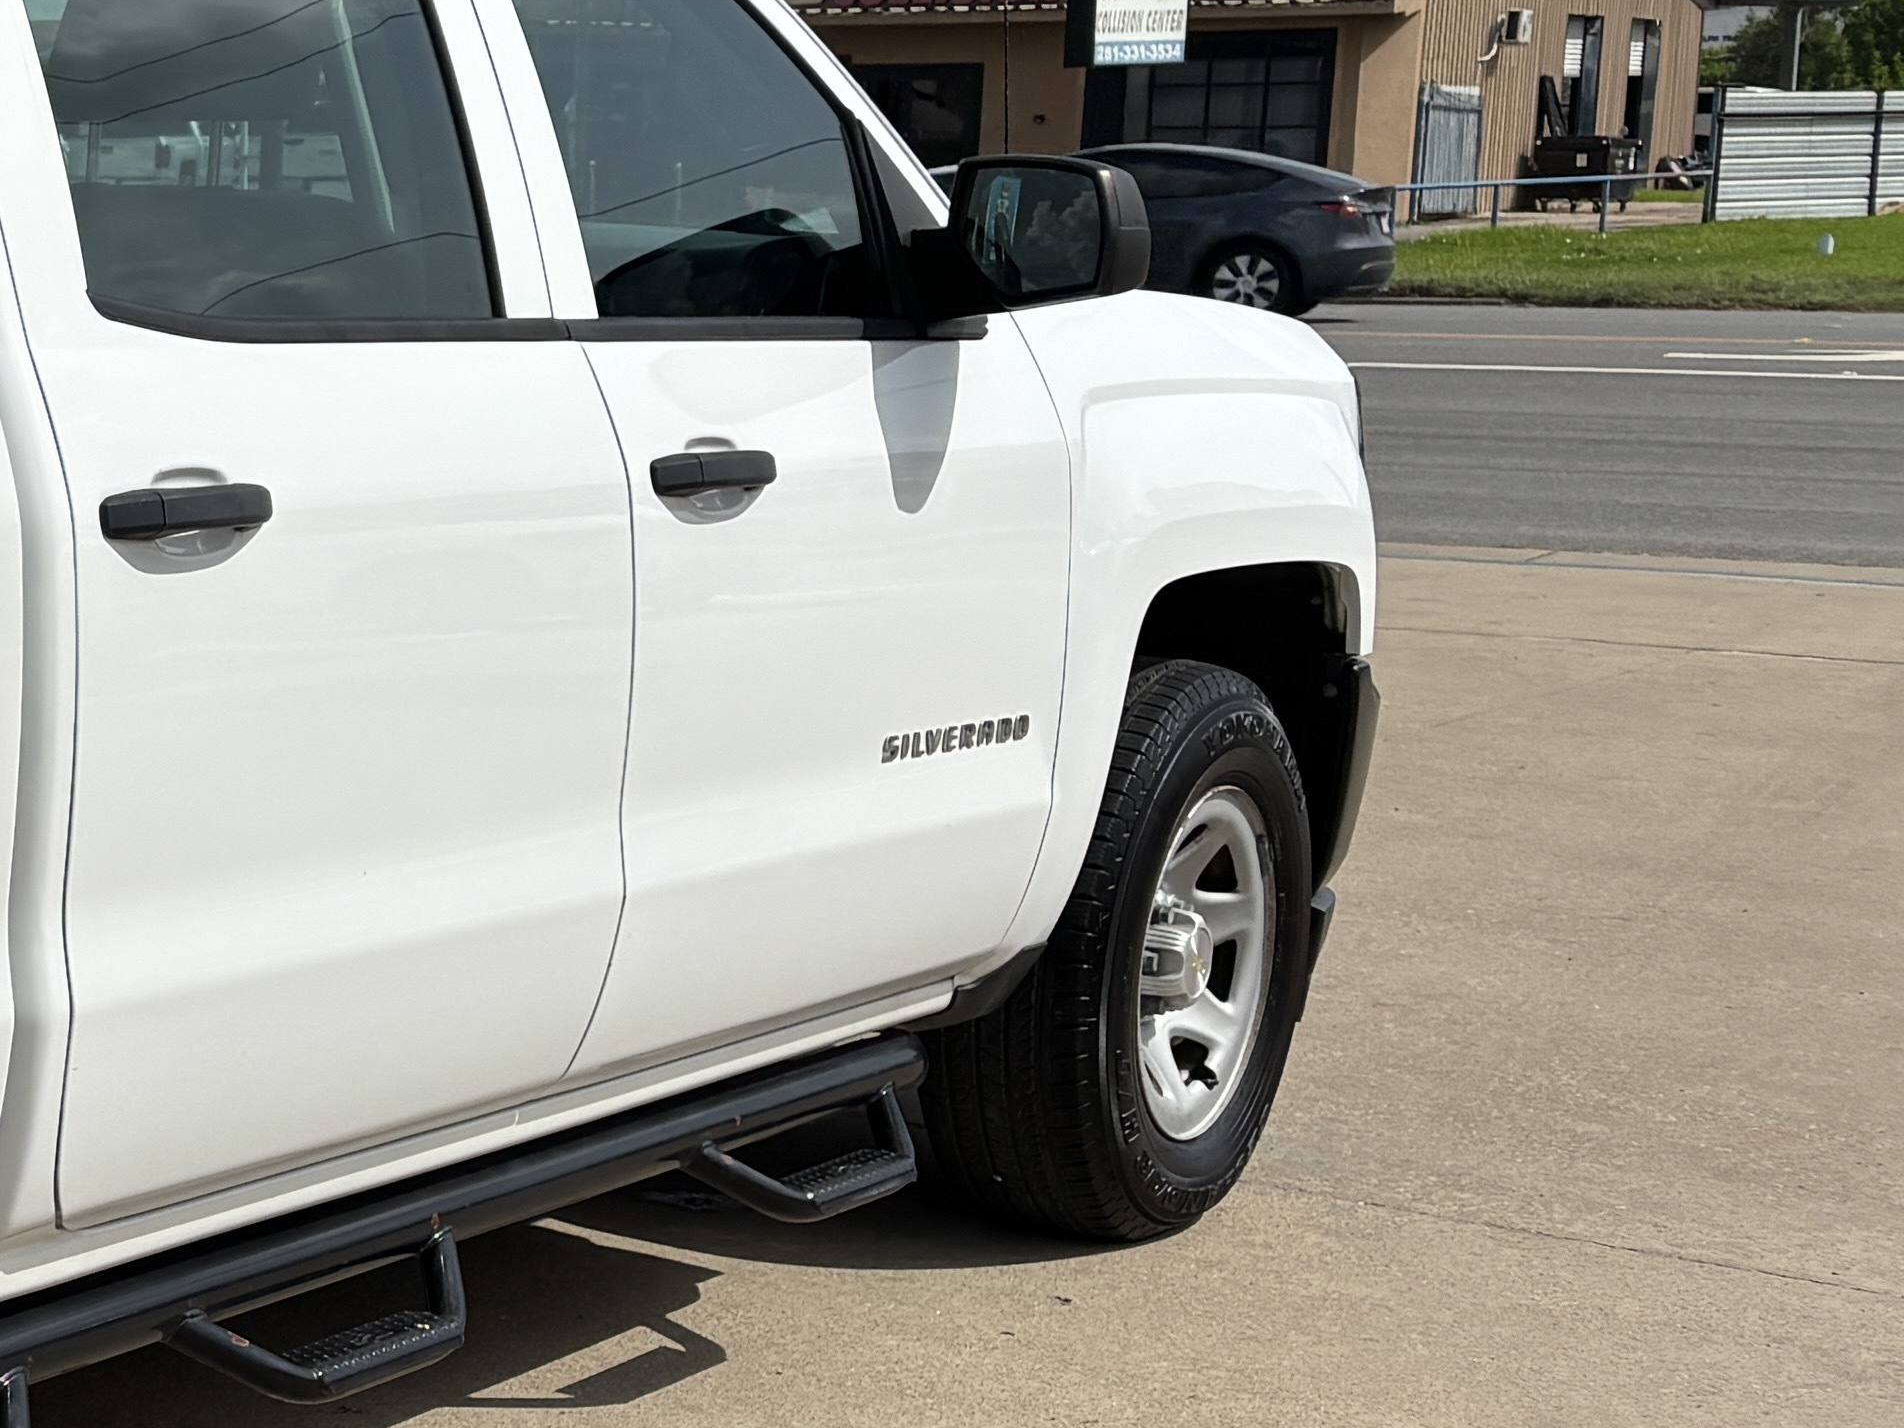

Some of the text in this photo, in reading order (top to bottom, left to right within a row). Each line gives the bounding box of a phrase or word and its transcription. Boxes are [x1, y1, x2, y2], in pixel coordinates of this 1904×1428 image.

[1096, 9, 1184, 34] COLLISION CENTER
[881, 714, 1030, 764] SILVERADO
